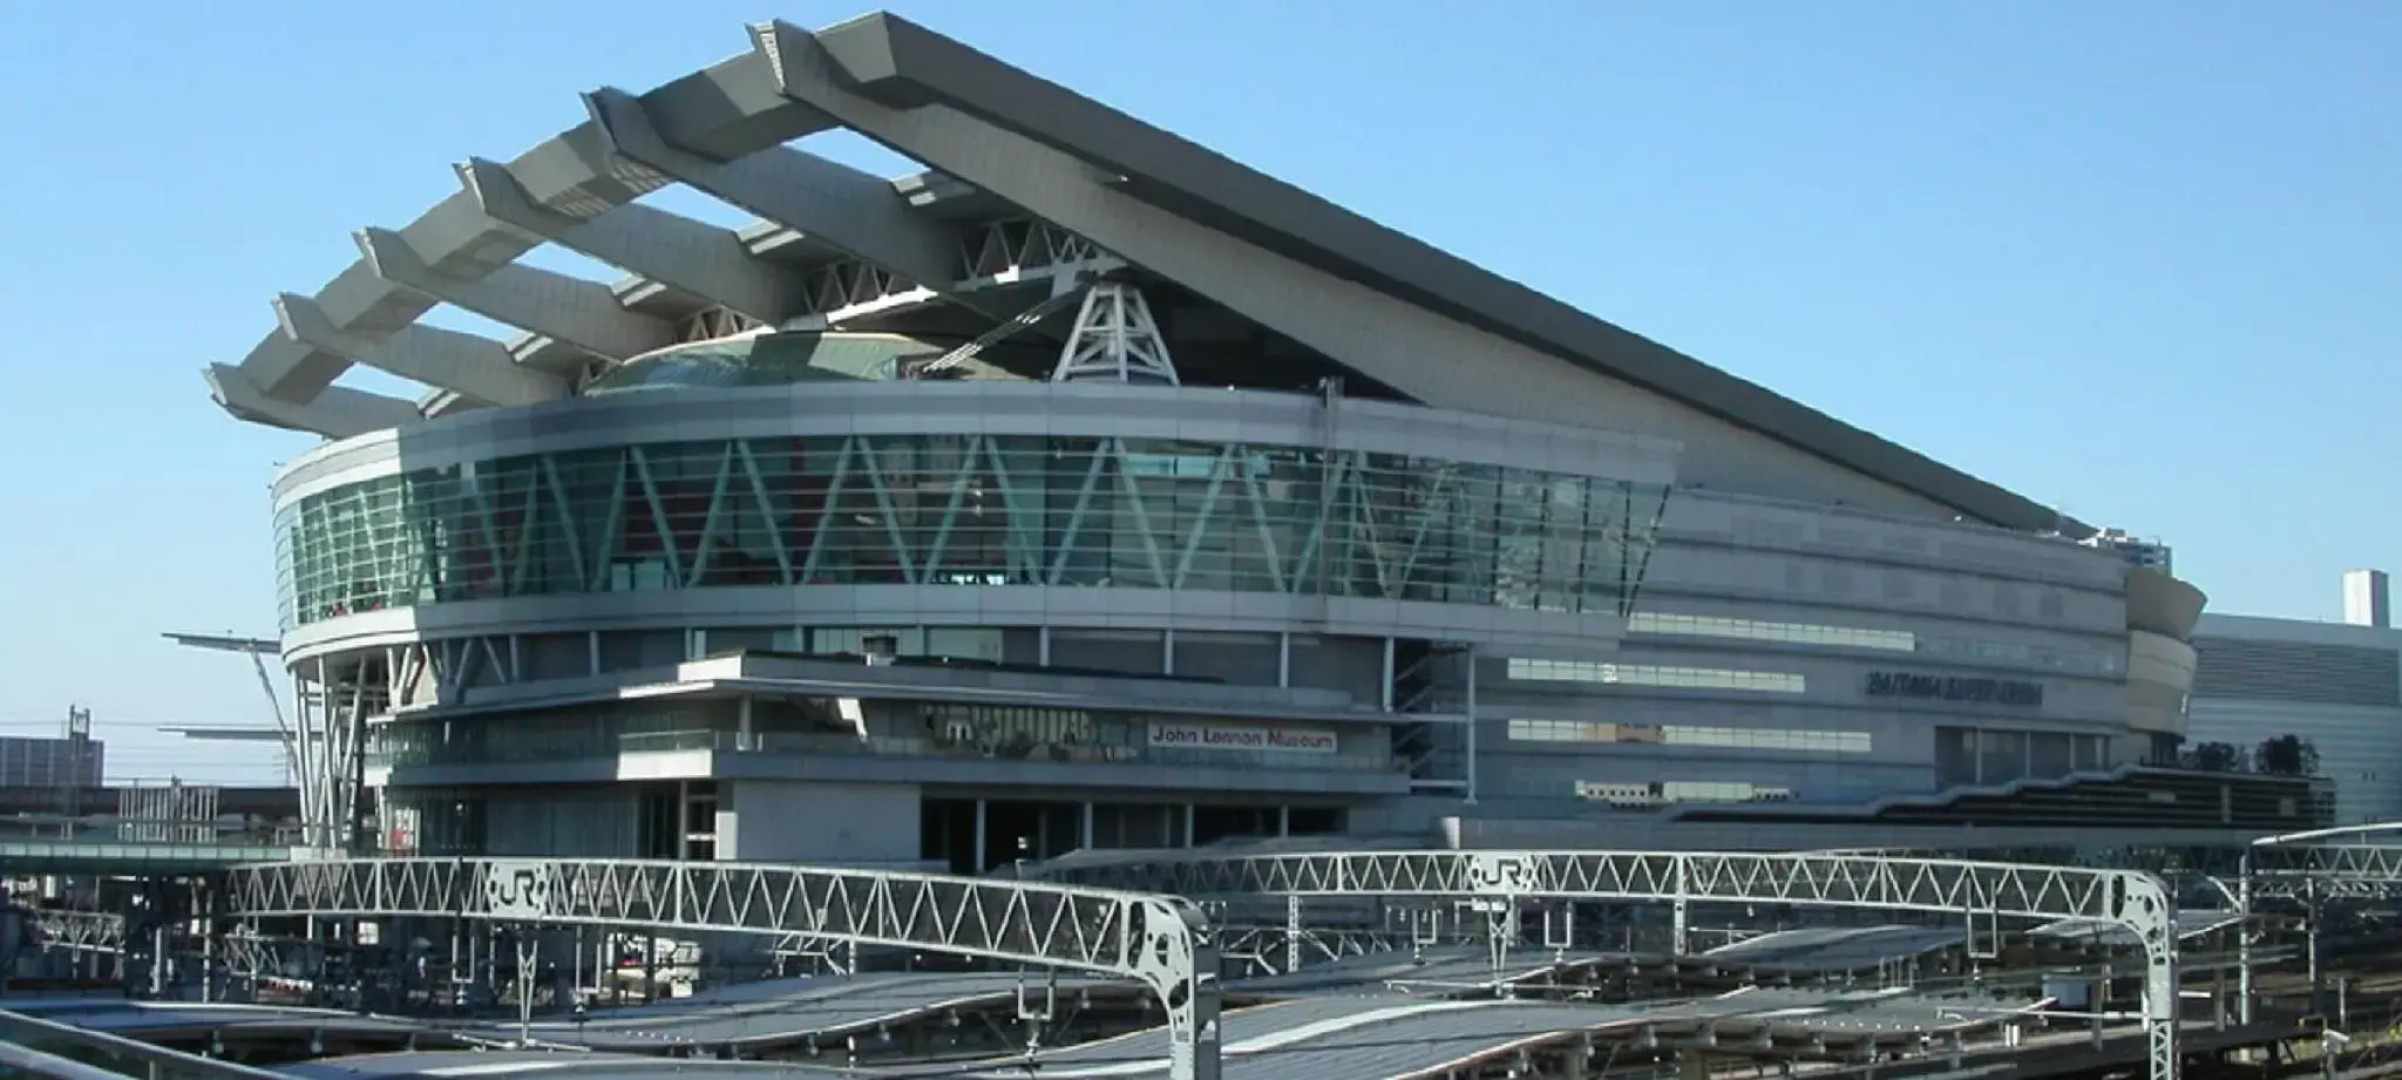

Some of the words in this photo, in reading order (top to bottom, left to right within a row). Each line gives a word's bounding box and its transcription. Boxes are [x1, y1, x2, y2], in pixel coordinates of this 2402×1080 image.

[1153, 726, 1197, 743] John
[1203, 727, 1262, 745] Lennon
[1267, 729, 1333, 749] Museum
[1482, 859, 1521, 885] JR
[500, 870, 535, 906] JR
